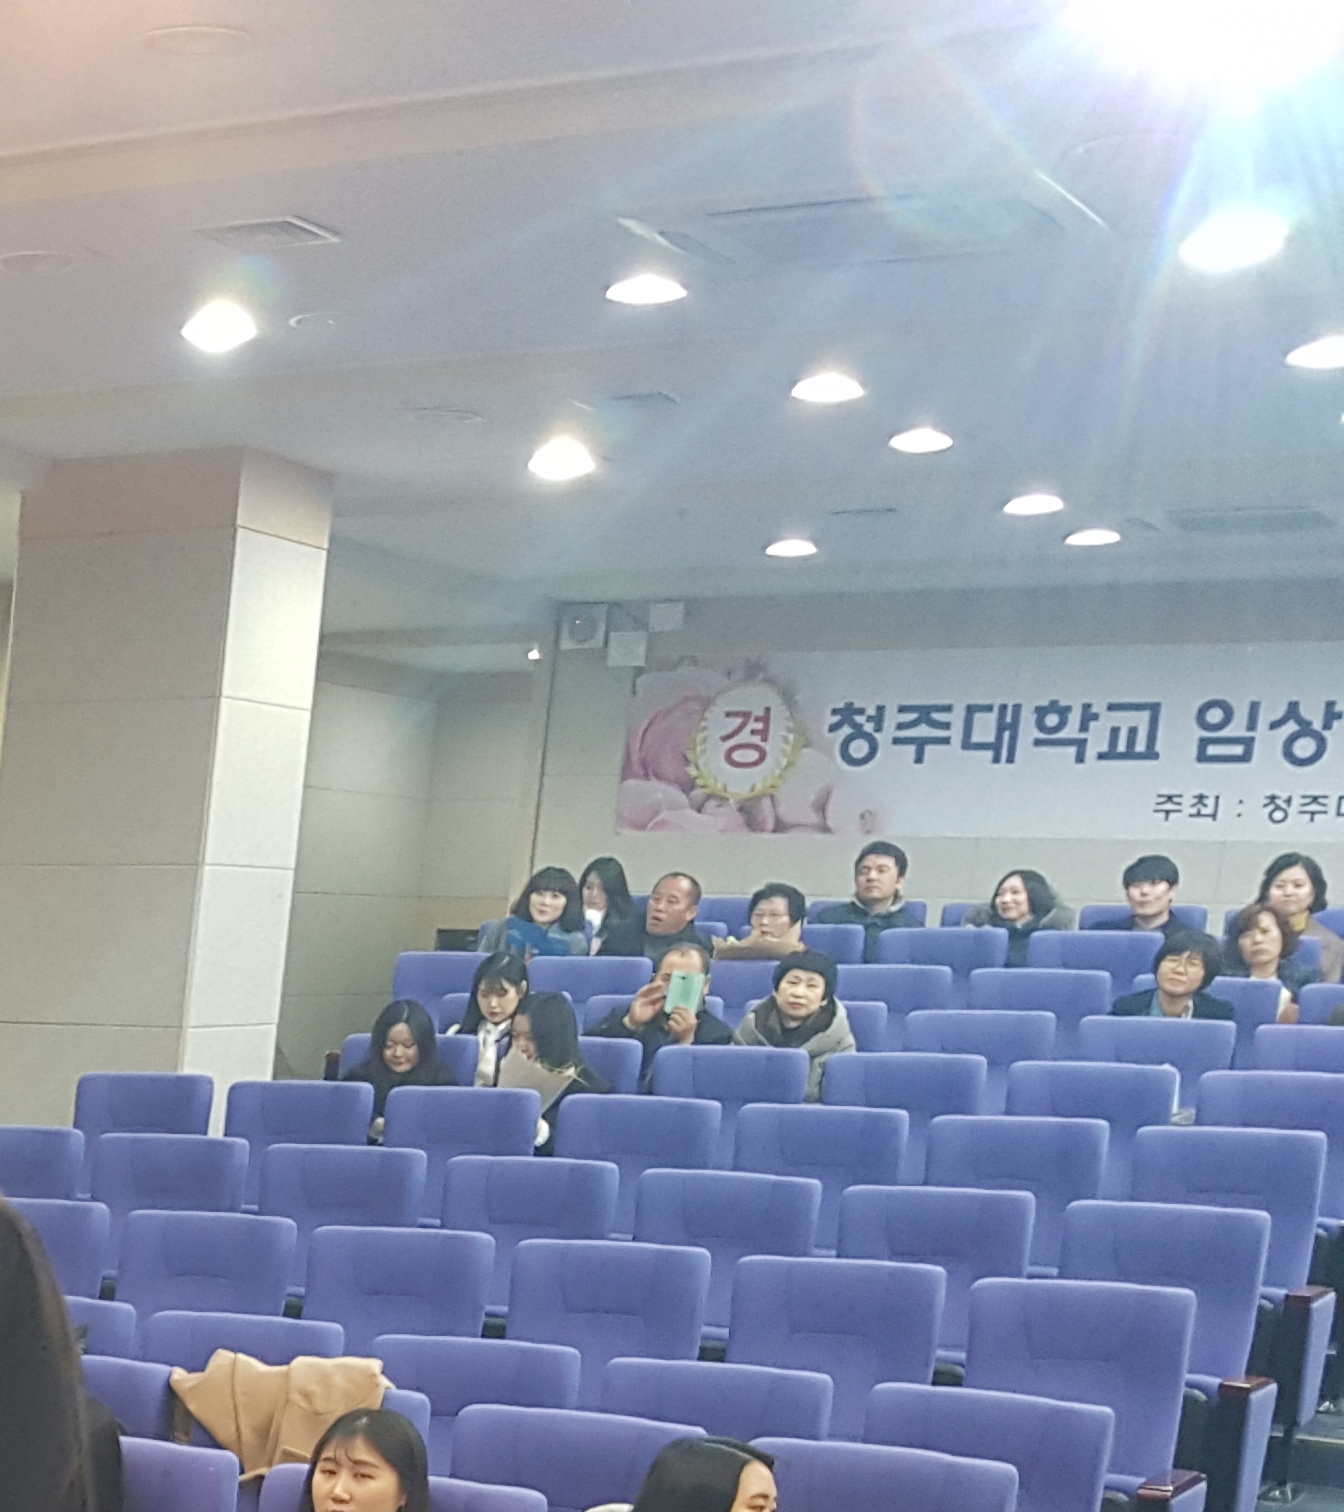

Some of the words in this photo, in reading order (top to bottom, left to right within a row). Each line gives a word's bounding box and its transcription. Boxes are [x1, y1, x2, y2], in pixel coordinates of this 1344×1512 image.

[719, 706, 772, 769] 경
[826, 700, 1162, 768] 청주대학교
[1195, 698, 1344, 767] 임상
[1152, 793, 1220, 822] 주최
[1262, 794, 1344, 824] 청주
